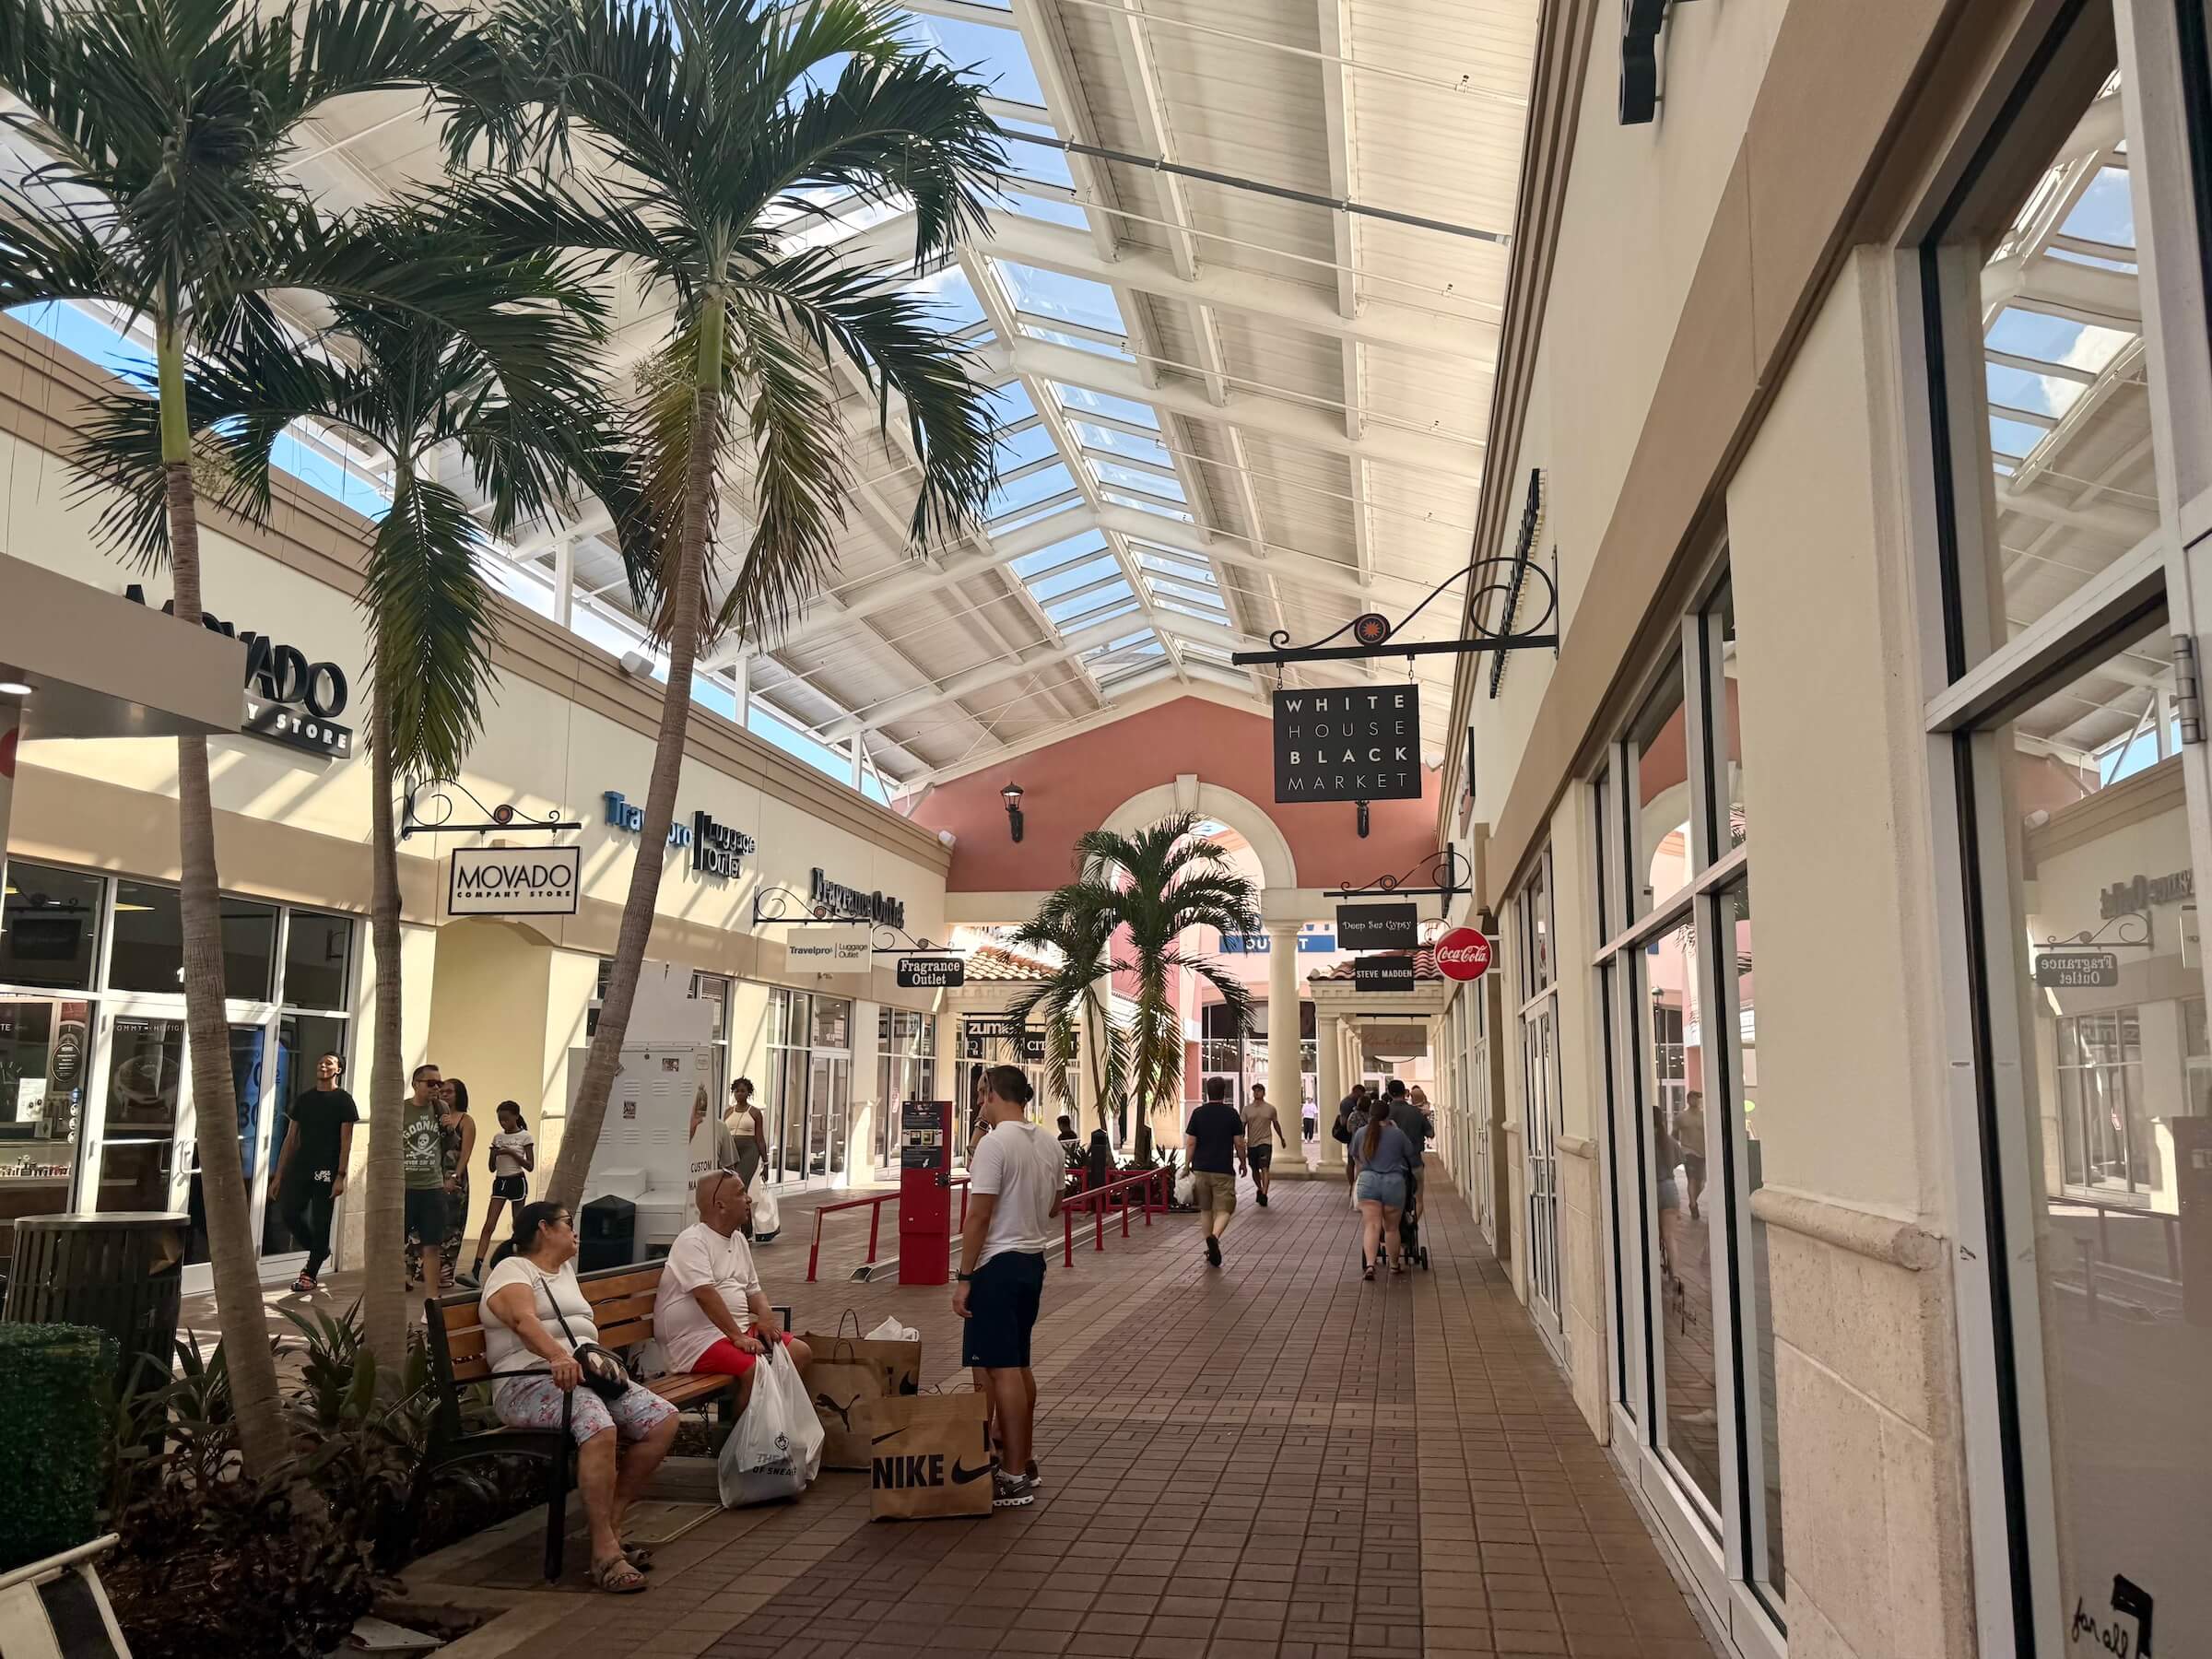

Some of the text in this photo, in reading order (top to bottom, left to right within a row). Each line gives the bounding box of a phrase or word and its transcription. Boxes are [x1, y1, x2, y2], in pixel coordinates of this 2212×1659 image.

[1286, 695, 1405, 712] WHITE
[276, 713, 347, 749] STORE
[1288, 721, 1405, 738] HOUSE
[1290, 747, 1407, 765] BLACK
[1288, 773, 1407, 791] MARKET
[703, 815, 756, 855] Luggage
[457, 865, 571, 888] MOVADO
[1342, 922, 1365, 931] Deep
[1386, 920, 1411, 931] Gypsy
[790, 946, 831, 956] Travelpro
[839, 943, 868, 951] Luggage
[900, 959, 960, 975] Fragrance
[1357, 971, 1379, 979] STEVE
[912, 973, 947, 985] Outlet
[403, 1121, 441, 1138] GOONIE
[691, 1161, 712, 1173] CUSTOM
[873, 1454, 944, 1489] NIKE
